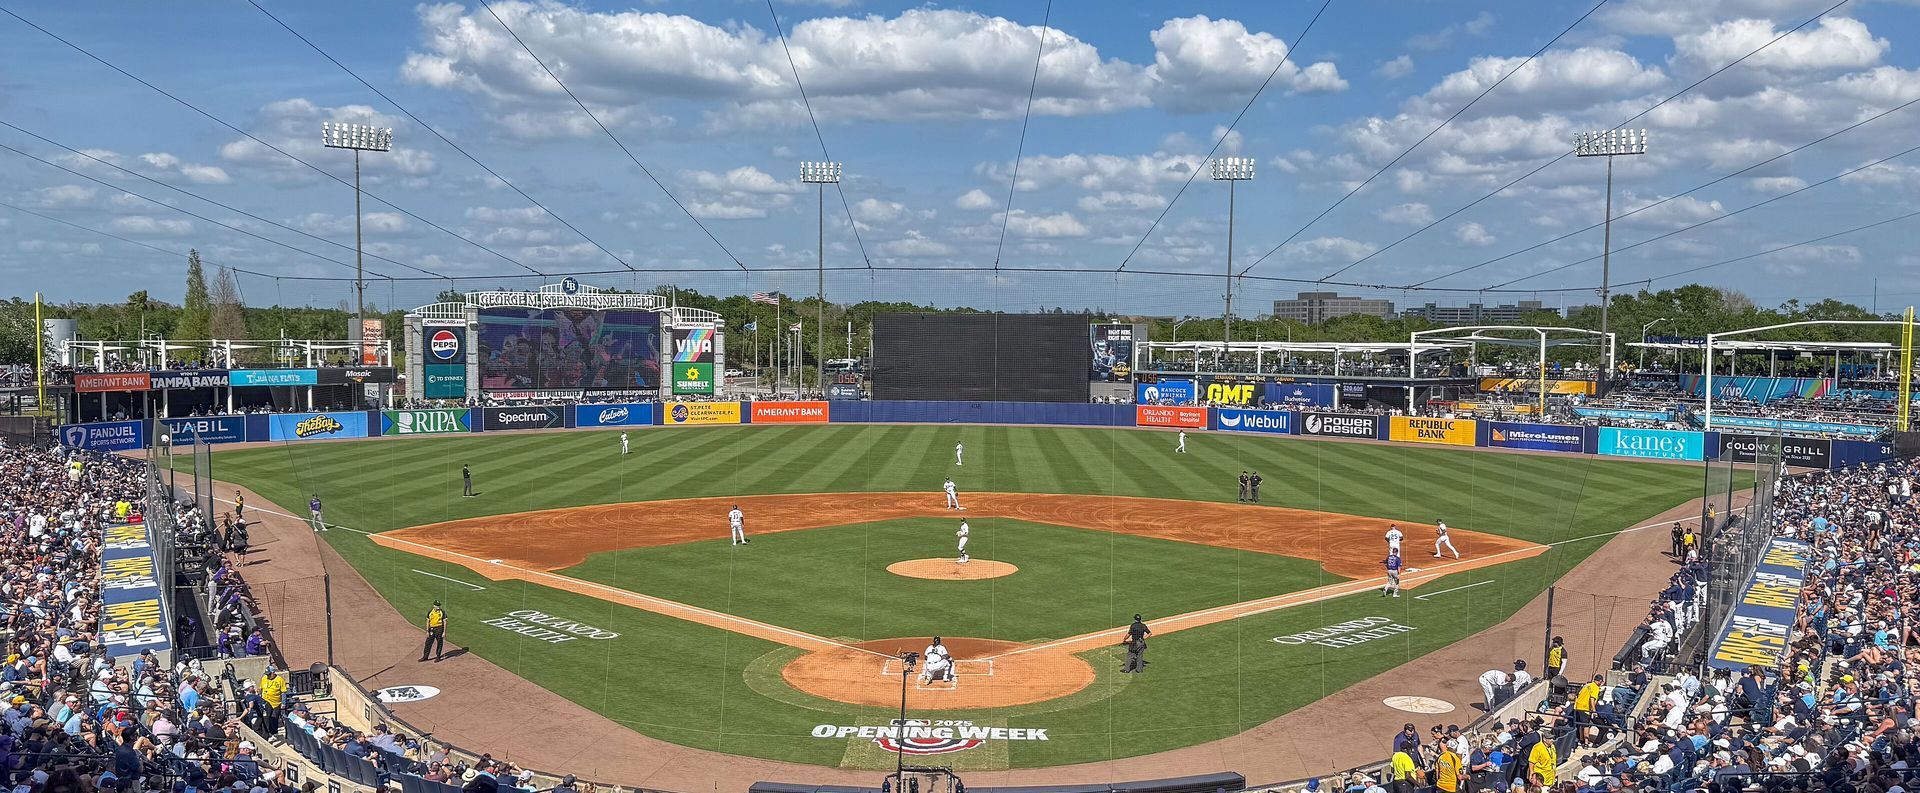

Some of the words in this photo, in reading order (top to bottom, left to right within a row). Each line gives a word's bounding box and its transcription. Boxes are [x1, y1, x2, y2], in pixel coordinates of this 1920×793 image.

[480, 294, 526, 306] GEORGE
[542, 294, 624, 307] STEINBRENNER
[625, 296, 655, 307] FIELD
[676, 339, 712, 352] VIVA
[246, 371, 280, 384] TIJUANA
[280, 374, 300, 382] FLATS
[345, 370, 372, 378] Mosaic
[80, 378, 120, 388] AMERANT
[122, 377, 145, 386] BANK
[151, 376, 192, 388] TAMPA
[1208, 384, 1254, 404] GMF
[498, 412, 547, 424] Spectrum
[598, 407, 628, 423] Culver's
[758, 408, 800, 416] AMERANT
[802, 408, 823, 416] BANK
[172, 420, 228, 434] JABIL
[416, 412, 460, 432] RIPA
[1244, 414, 1286, 429] Webull
[1410, 420, 1455, 430] REPUBLIC
[90, 426, 136, 439] FANDUEL
[1418, 429, 1445, 439] BANK
[1510, 431, 1579, 441] MicroLumen
[1616, 430, 1686, 452] kane's
[1616, 450, 1684, 458] FURNITURE
[1726, 442, 1770, 451] COLONY
[1784, 446, 1824, 456] GRILL
[480, 616, 578, 644] HEALTH
[508, 609, 622, 640] ORLANDO
[1268, 616, 1394, 645] ORLANDO
[1312, 623, 1418, 648] HEALTH
[810, 724, 954, 738] OPENING
[958, 726, 1049, 741] WEEK
